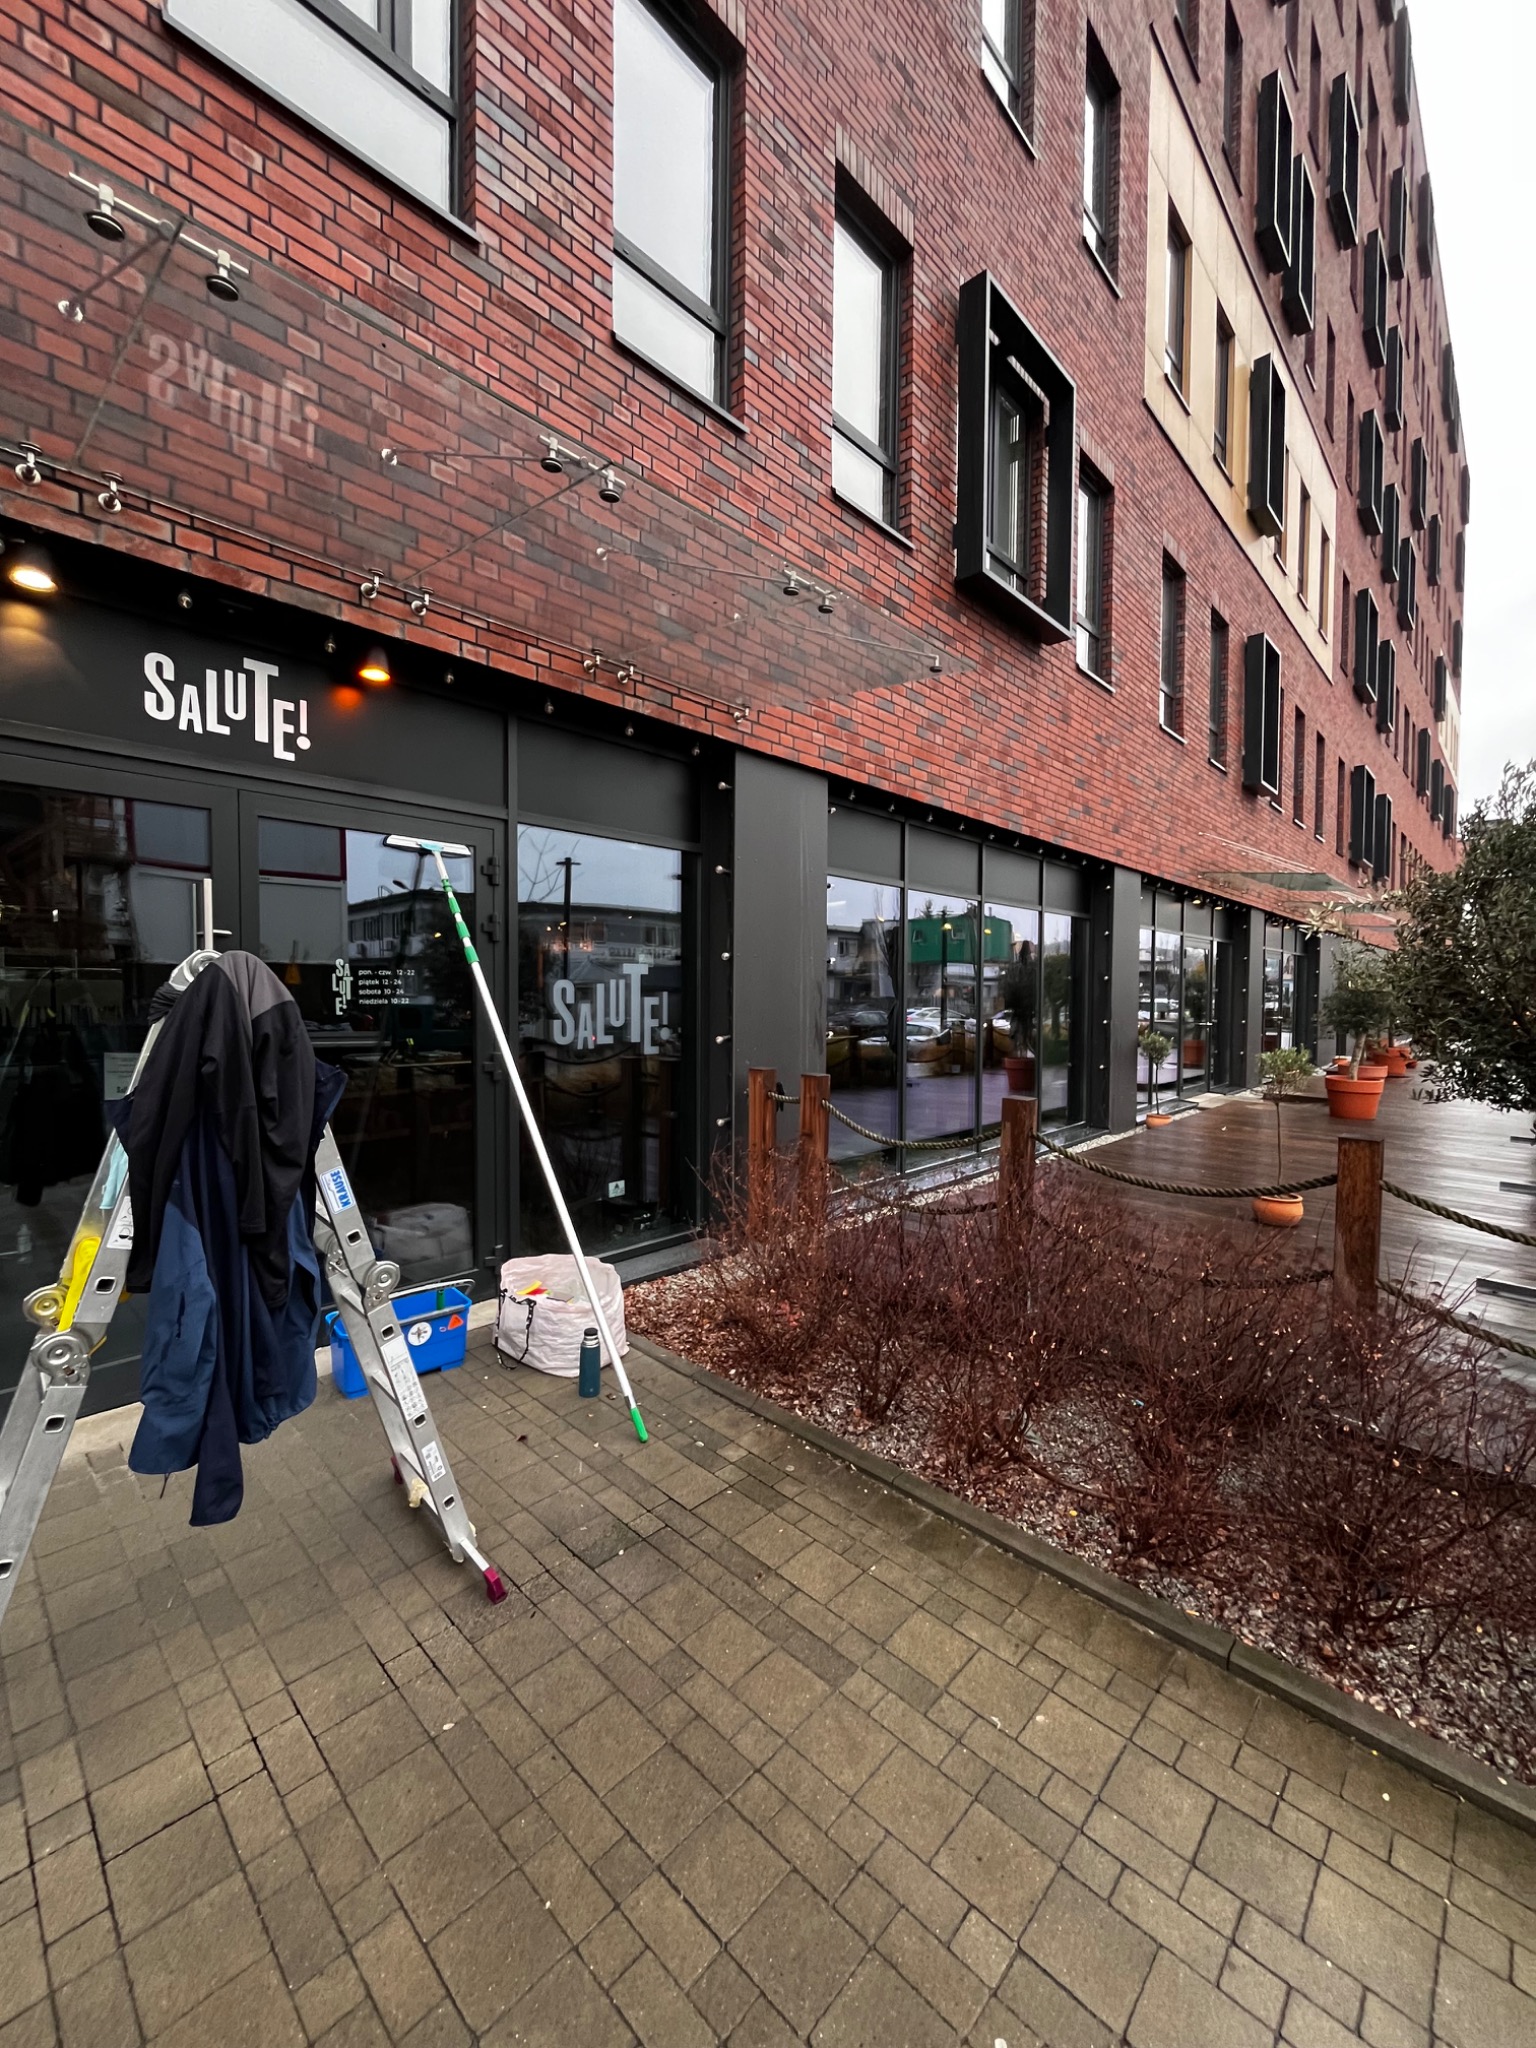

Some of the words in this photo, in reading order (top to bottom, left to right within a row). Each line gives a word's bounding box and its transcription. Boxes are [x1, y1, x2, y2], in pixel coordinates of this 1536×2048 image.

[144, 652, 311, 761] SALUTE!
[359, 997, 388, 1005] niedziela
[553, 963, 671, 1055] SALUTE!
[330, 1170, 351, 1207] KRAUSE
